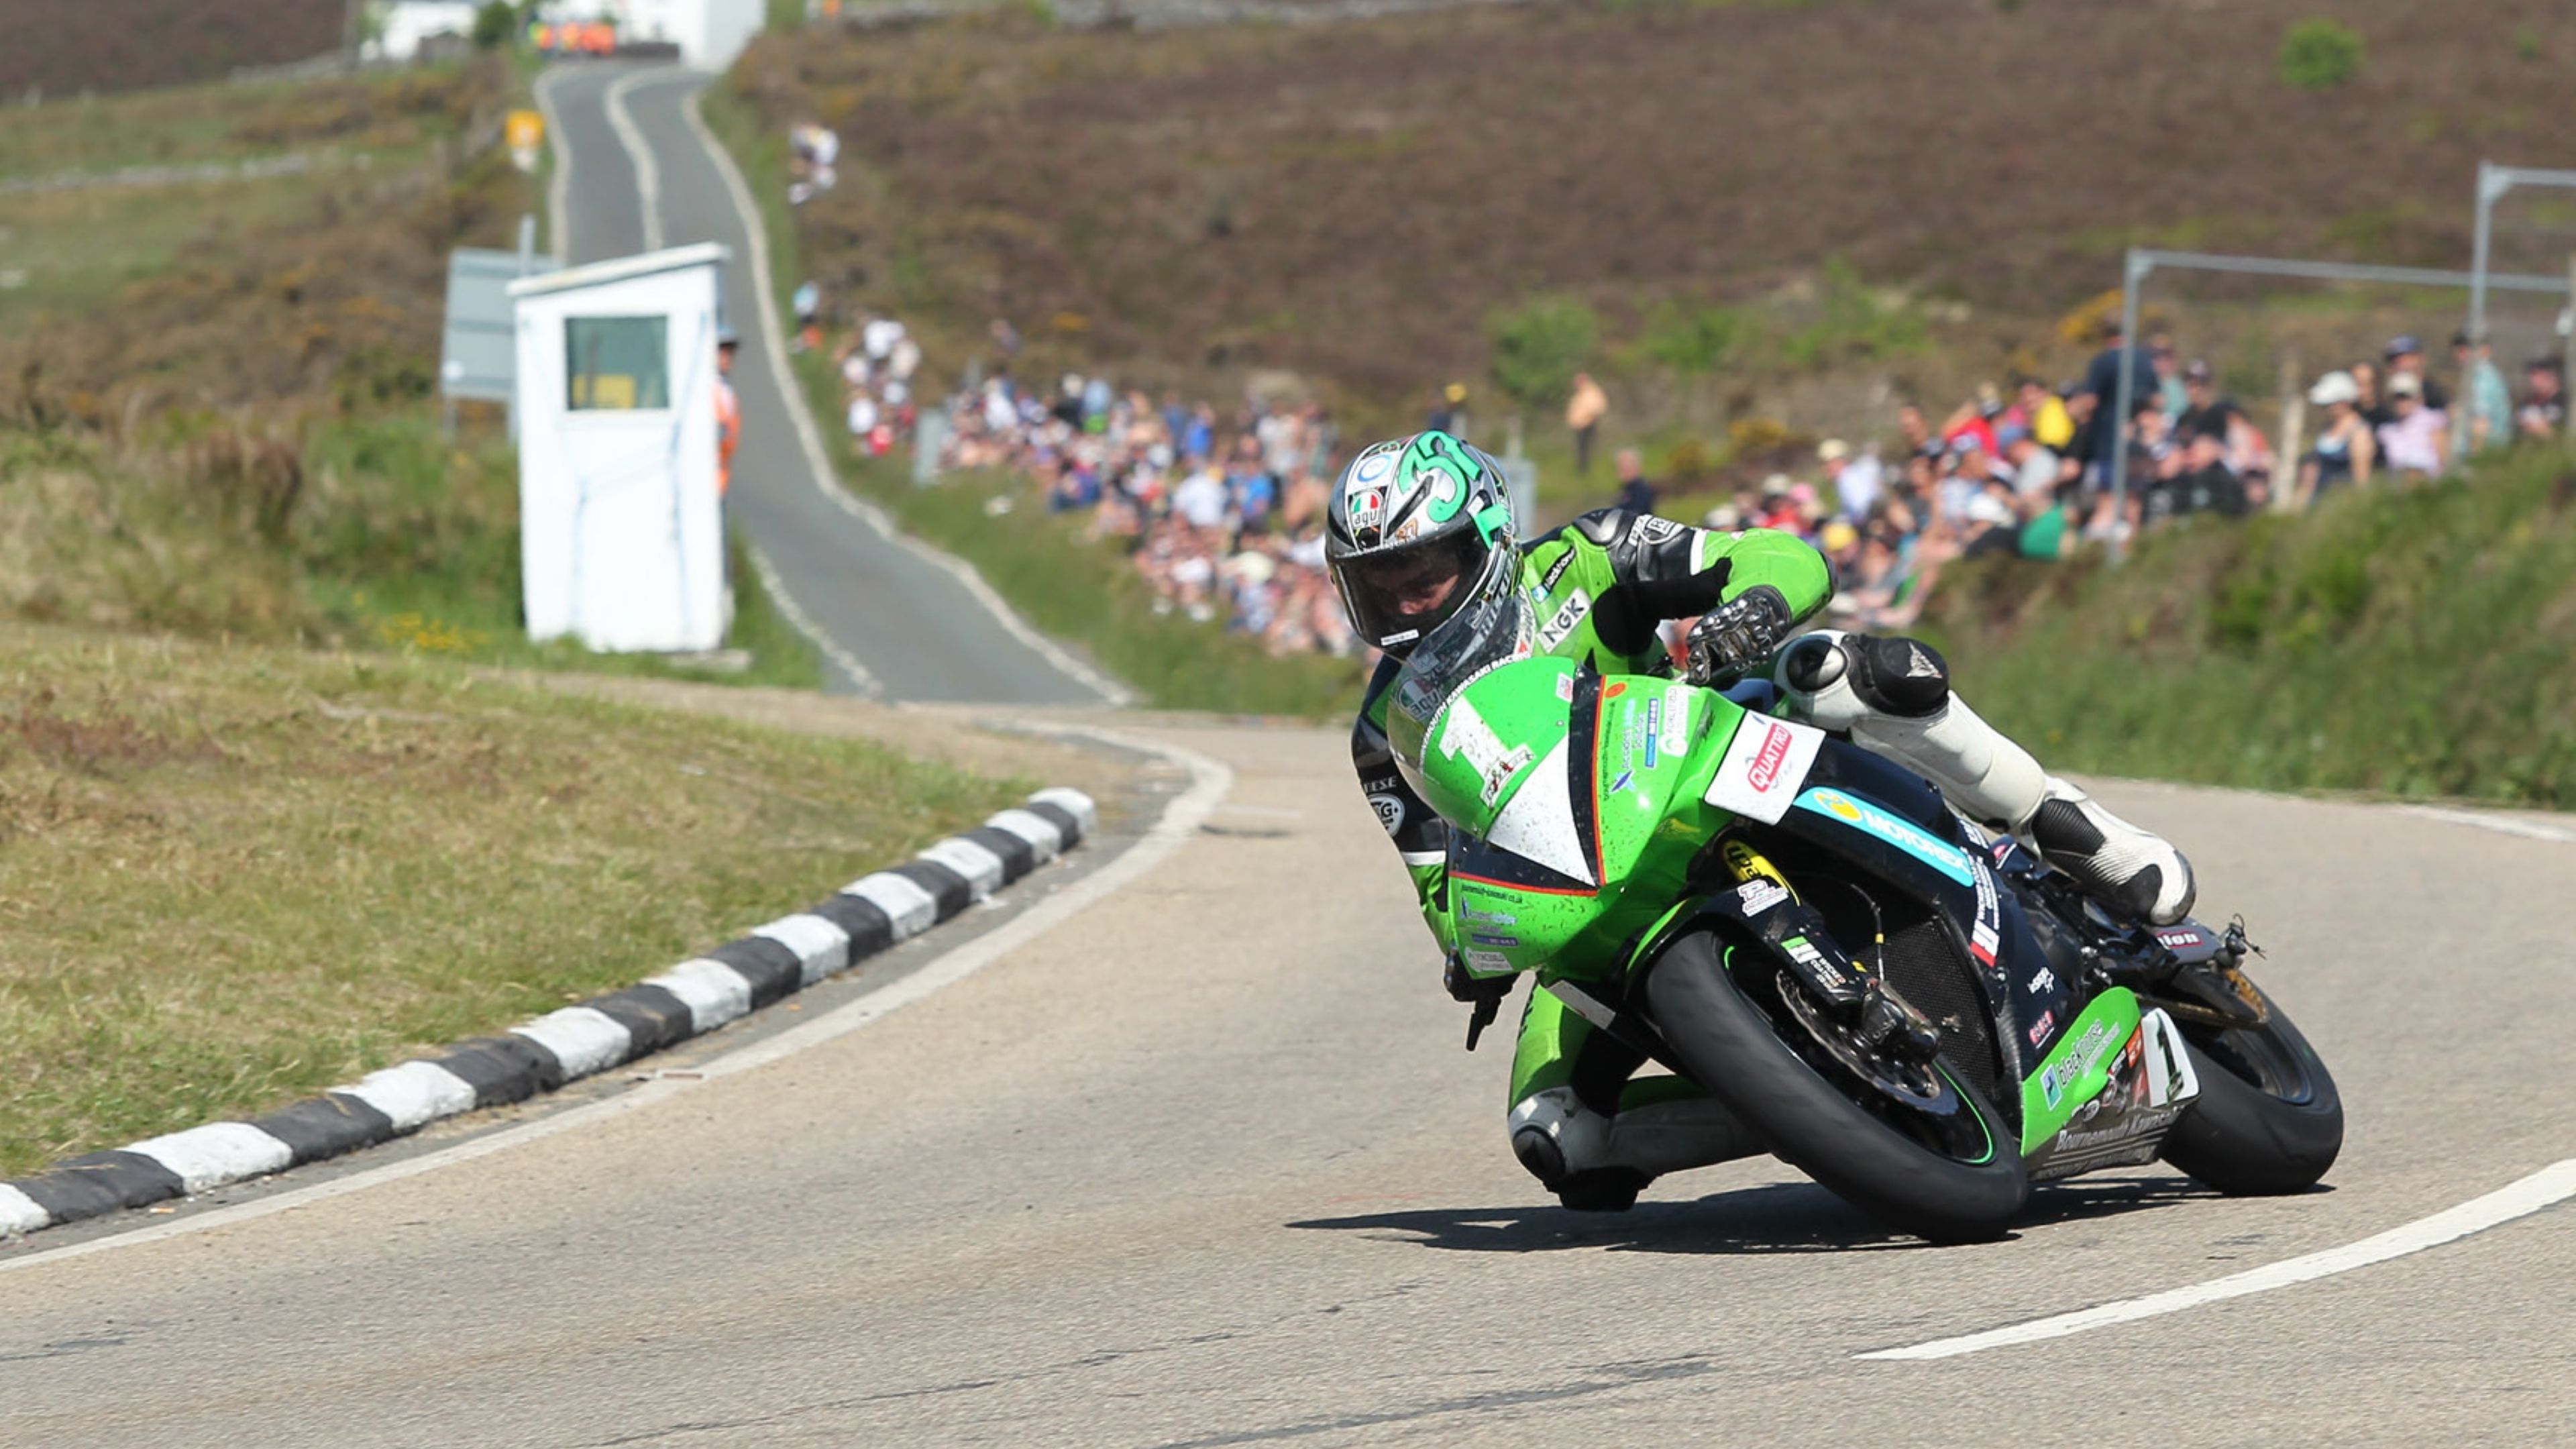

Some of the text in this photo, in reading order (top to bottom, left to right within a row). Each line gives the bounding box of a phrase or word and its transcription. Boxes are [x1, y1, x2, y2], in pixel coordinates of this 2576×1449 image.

[1544, 598, 1585, 643] NGK
[1445, 665, 1494, 707] KAWASAKI
[1439, 696, 1535, 808] 1
[1750, 724, 1790, 788] QUATTRO
[1861, 810, 1970, 872] MOTOREX
[2154, 1012, 2184, 1105] 1
